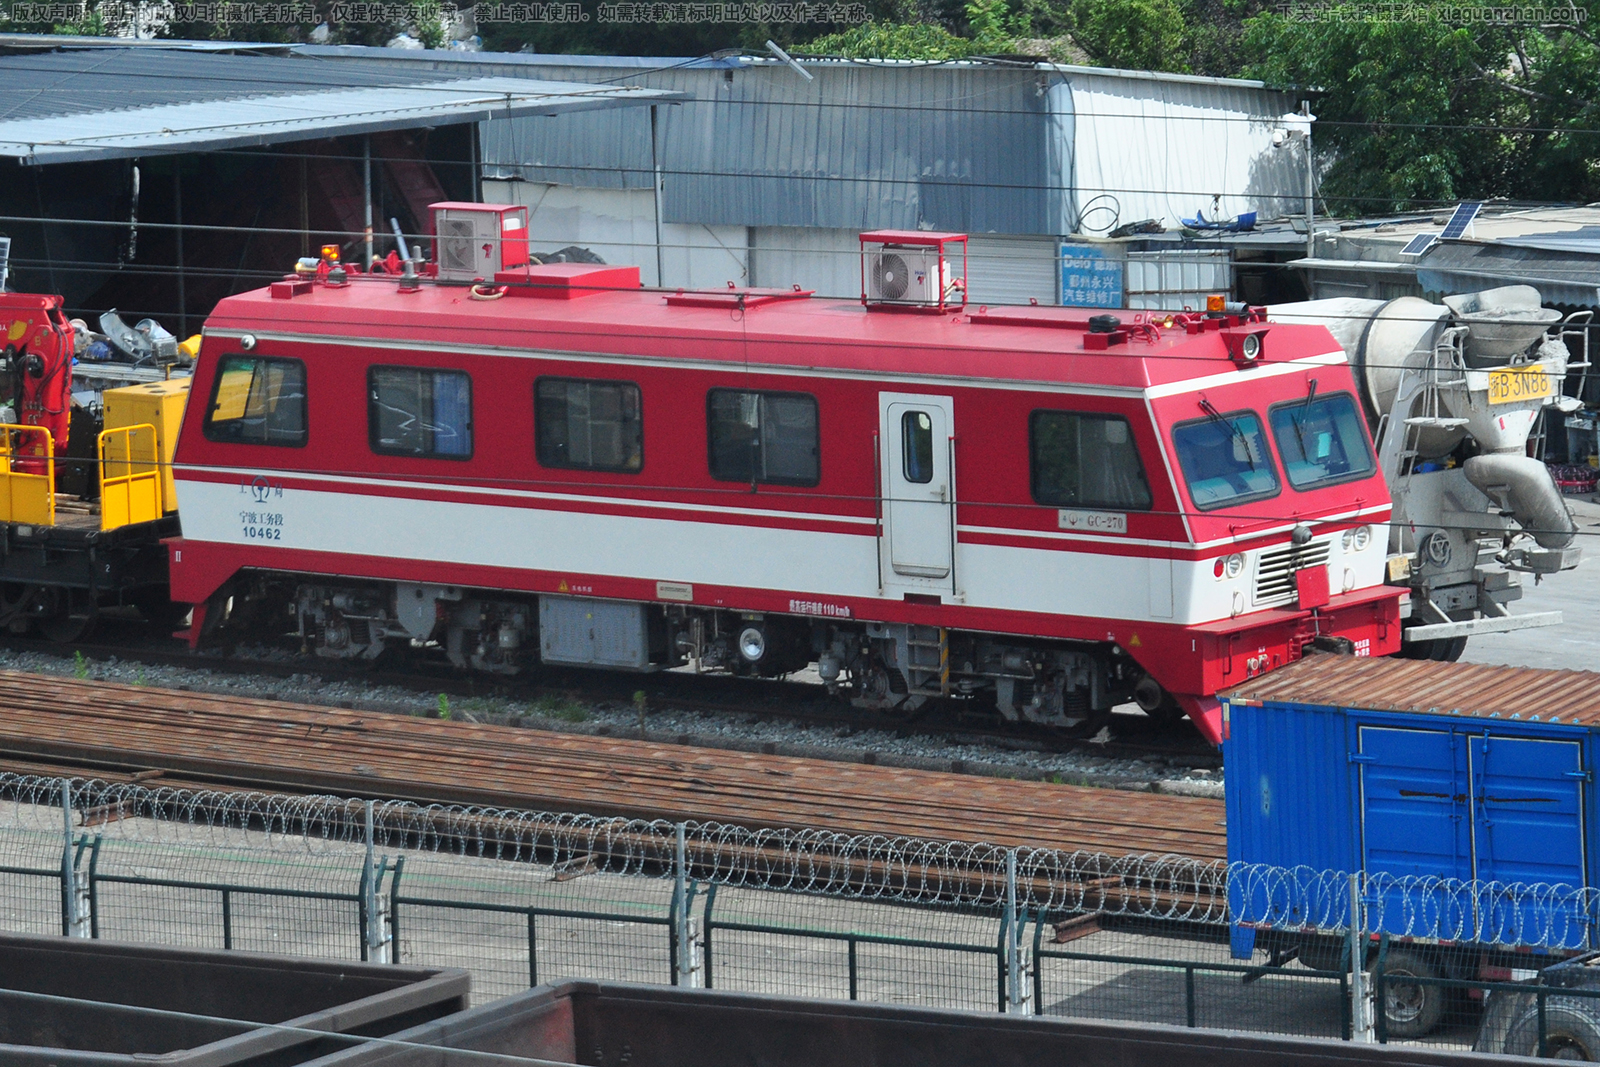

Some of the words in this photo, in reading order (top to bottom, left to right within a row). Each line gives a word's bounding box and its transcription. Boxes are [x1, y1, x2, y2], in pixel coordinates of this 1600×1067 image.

[1064, 289, 1120, 304] 汽车维修厂
[239, 510, 284, 526] 宁波工务段
[1087, 514, 1124, 529] GC-270
[243, 526, 281, 540] 10462
